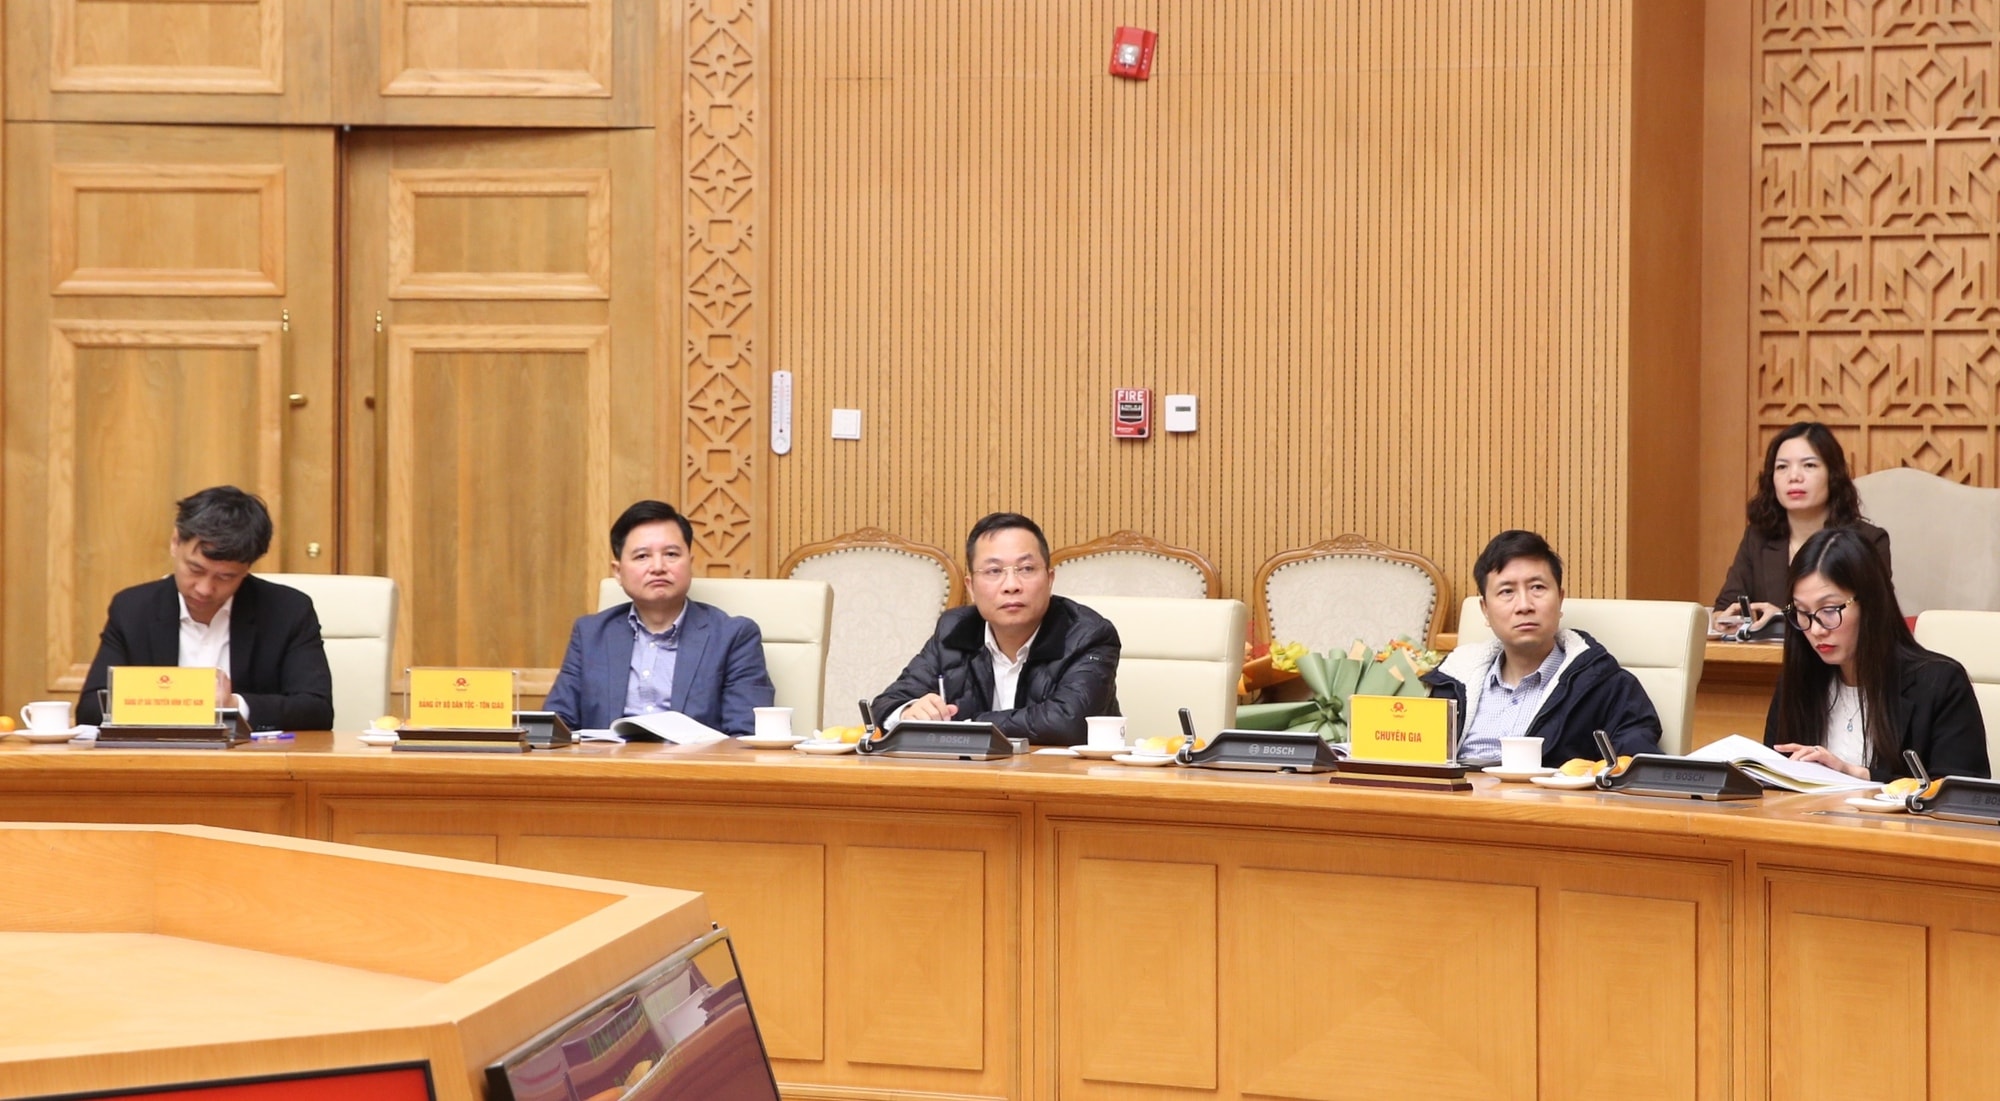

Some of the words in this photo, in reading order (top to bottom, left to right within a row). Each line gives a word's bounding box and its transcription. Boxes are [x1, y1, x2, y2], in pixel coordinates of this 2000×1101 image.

[1117, 390, 1145, 401] FIRE
[940, 735, 970, 745] BOSCH
[1375, 729, 1406, 742] CHUYÊN
[1408, 732, 1422, 743] GIA
[1263, 745, 1295, 755] BOSCH
[1675, 771, 1705, 782] BOSCH
